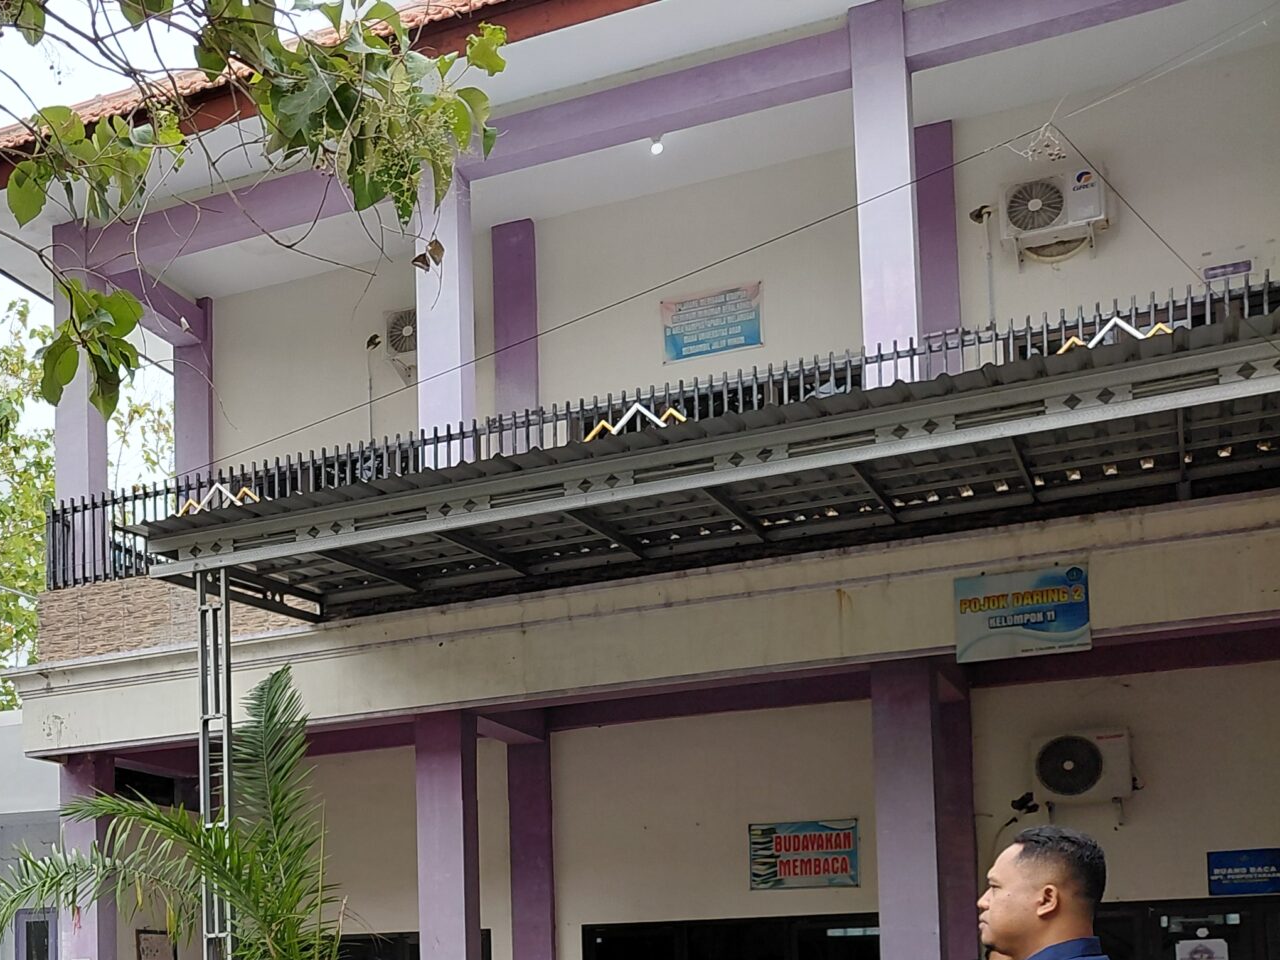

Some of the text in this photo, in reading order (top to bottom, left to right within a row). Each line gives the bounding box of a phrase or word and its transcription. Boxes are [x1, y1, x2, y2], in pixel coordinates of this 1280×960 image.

[960, 585, 1084, 614] POJOK DARING 2
[988, 611, 1044, 629] KELOMPOK
[774, 832, 852, 853] BUDAYAKAN
[779, 857, 848, 877] MEMBACA
